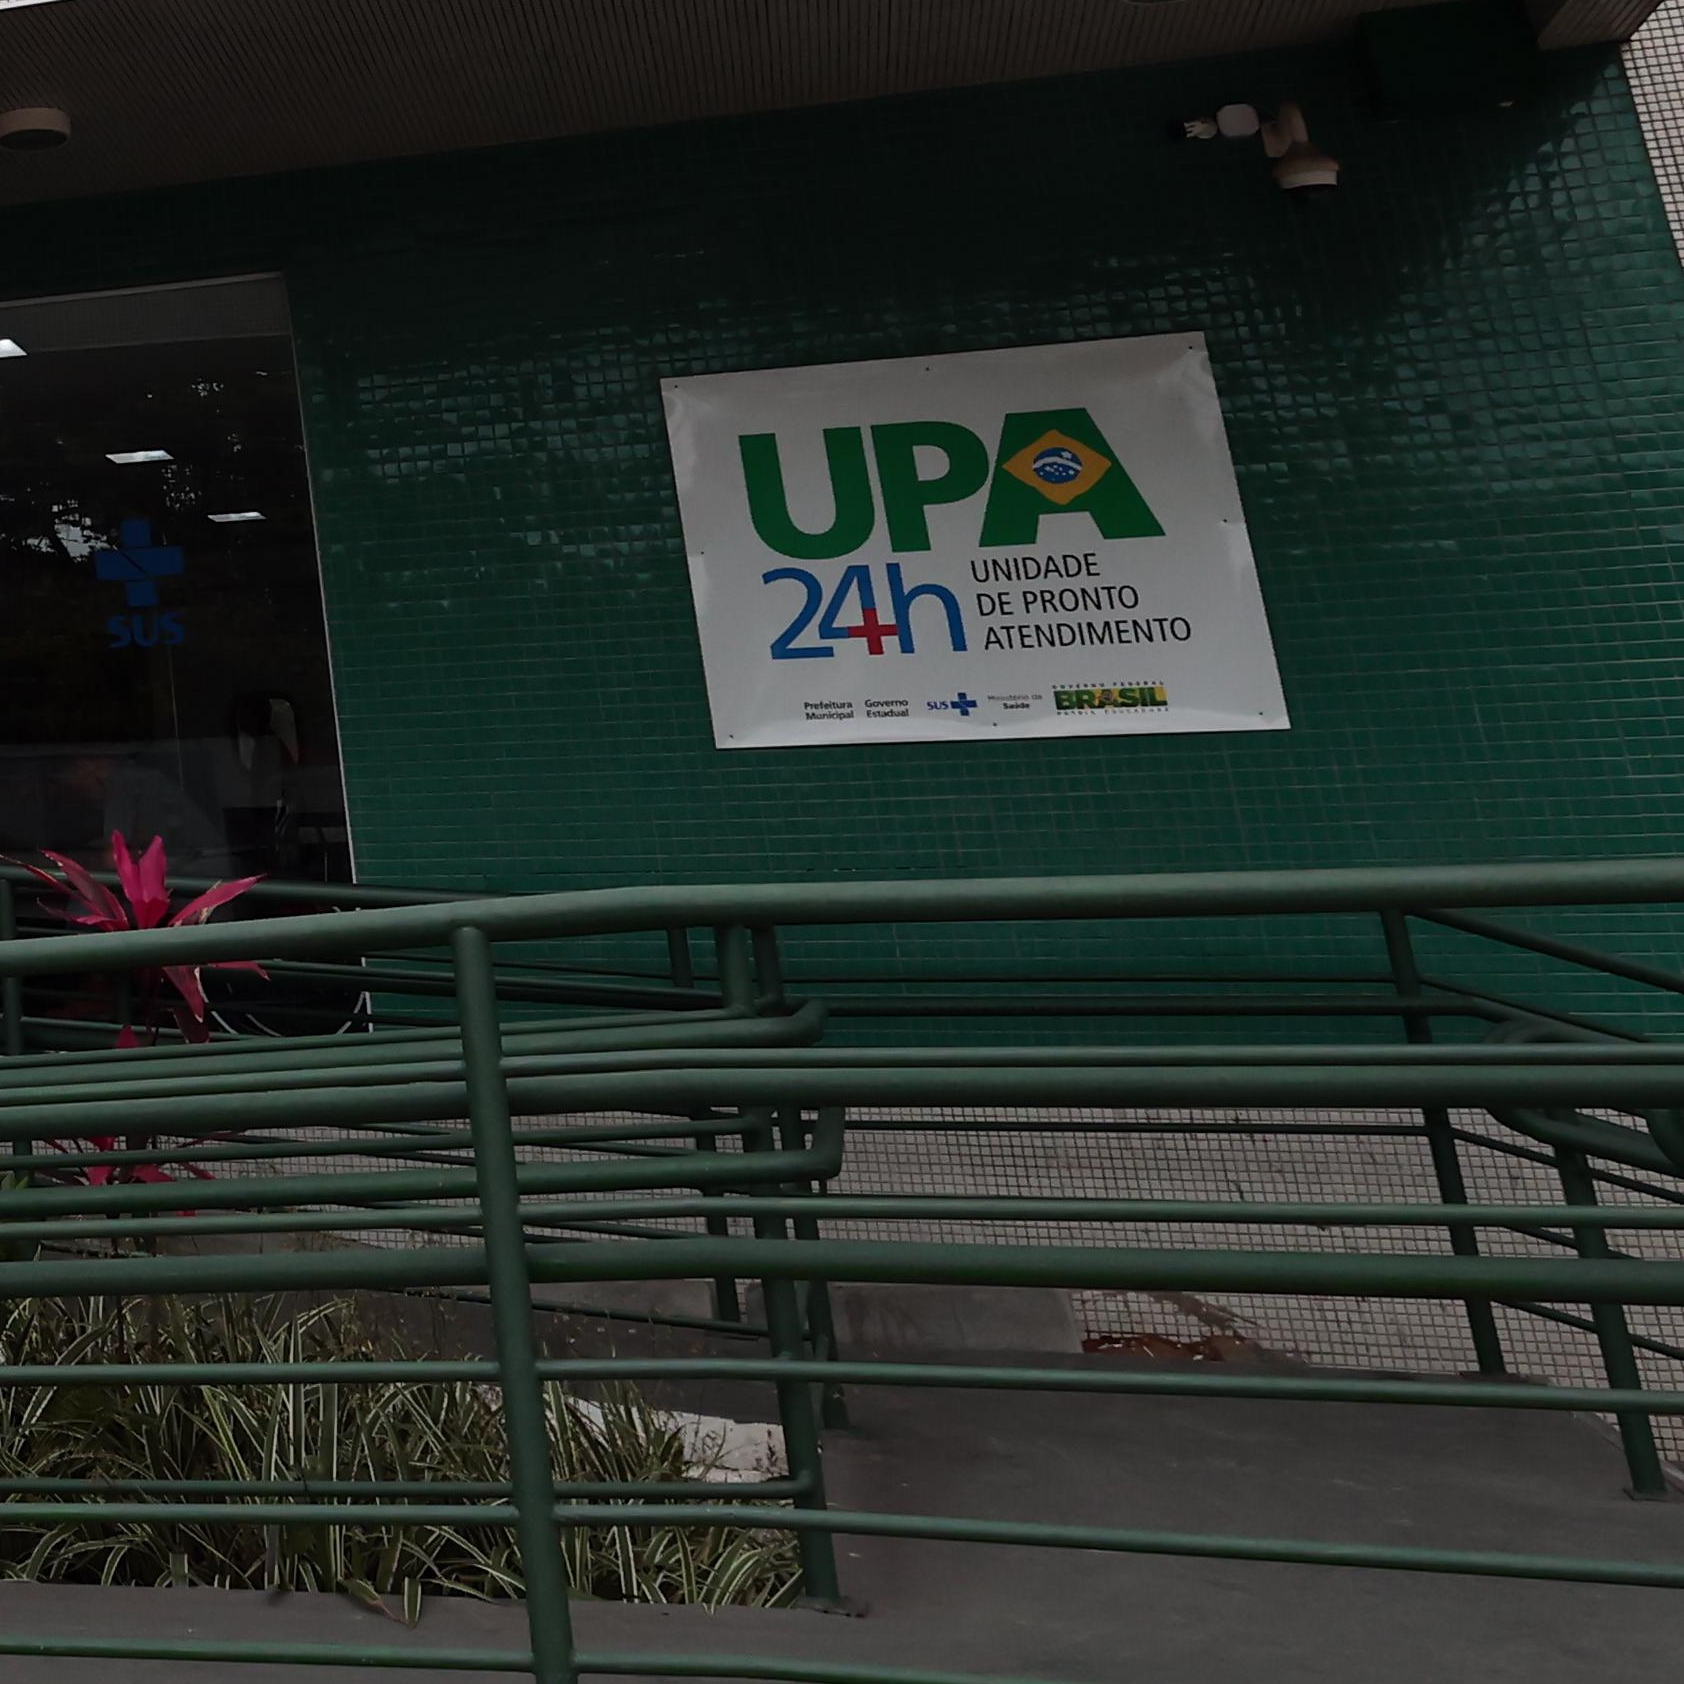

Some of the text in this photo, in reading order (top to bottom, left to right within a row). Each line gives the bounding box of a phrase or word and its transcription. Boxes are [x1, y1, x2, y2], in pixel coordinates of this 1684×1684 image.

[738, 407, 1166, 560] UPA
[970, 553, 1101, 584] UNIDADE
[761, 562, 967, 661] 24h
[976, 584, 1140, 618] DE PRONTO
[107, 611, 185, 649] SUS
[983, 616, 1192, 652] ATENDIMENTO
[803, 700, 854, 710] Prefeitura
[864, 698, 909, 708] Governo
[926, 700, 950, 711] SUS
[1053, 686, 1169, 711] BRASIL
[805, 710, 855, 721] Municipal
[866, 708, 910, 719] Estadual
